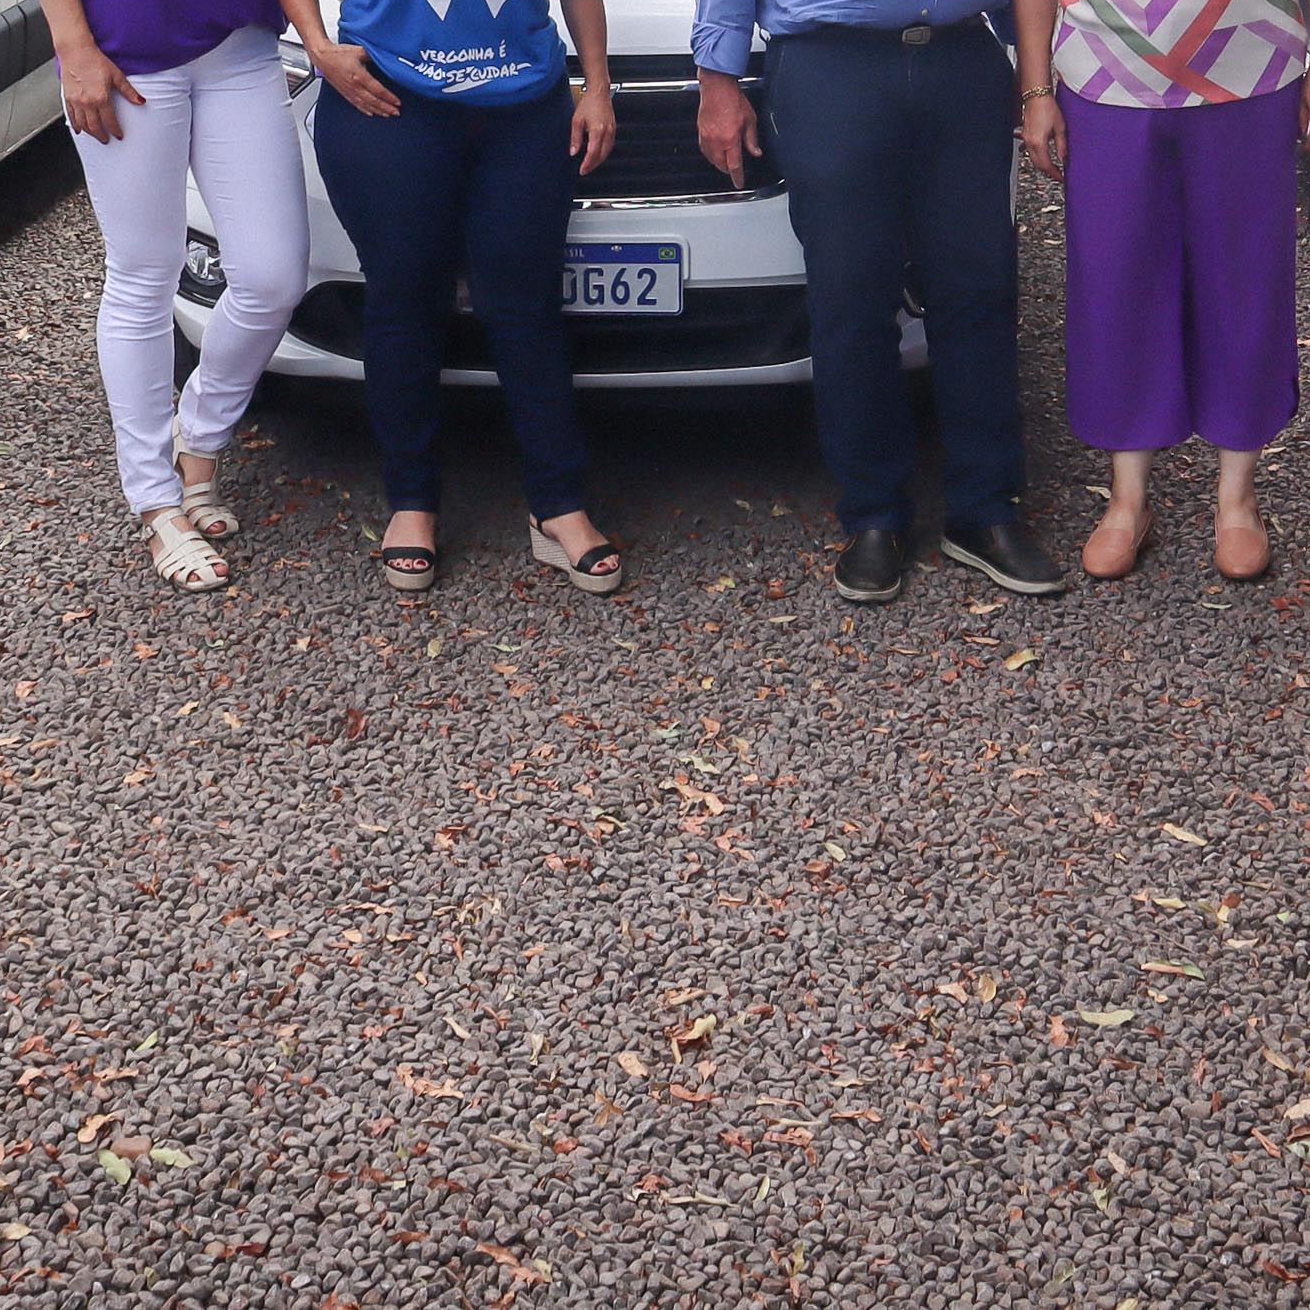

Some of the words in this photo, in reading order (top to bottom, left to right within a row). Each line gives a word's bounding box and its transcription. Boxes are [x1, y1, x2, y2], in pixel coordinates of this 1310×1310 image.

[420, 47, 495, 65] VERGONHA
[498, 39, 507, 58] É
[414, 62, 443, 81] NÃO
[446, 69, 466, 84] SE
[469, 63, 519, 81] CUIDAR
